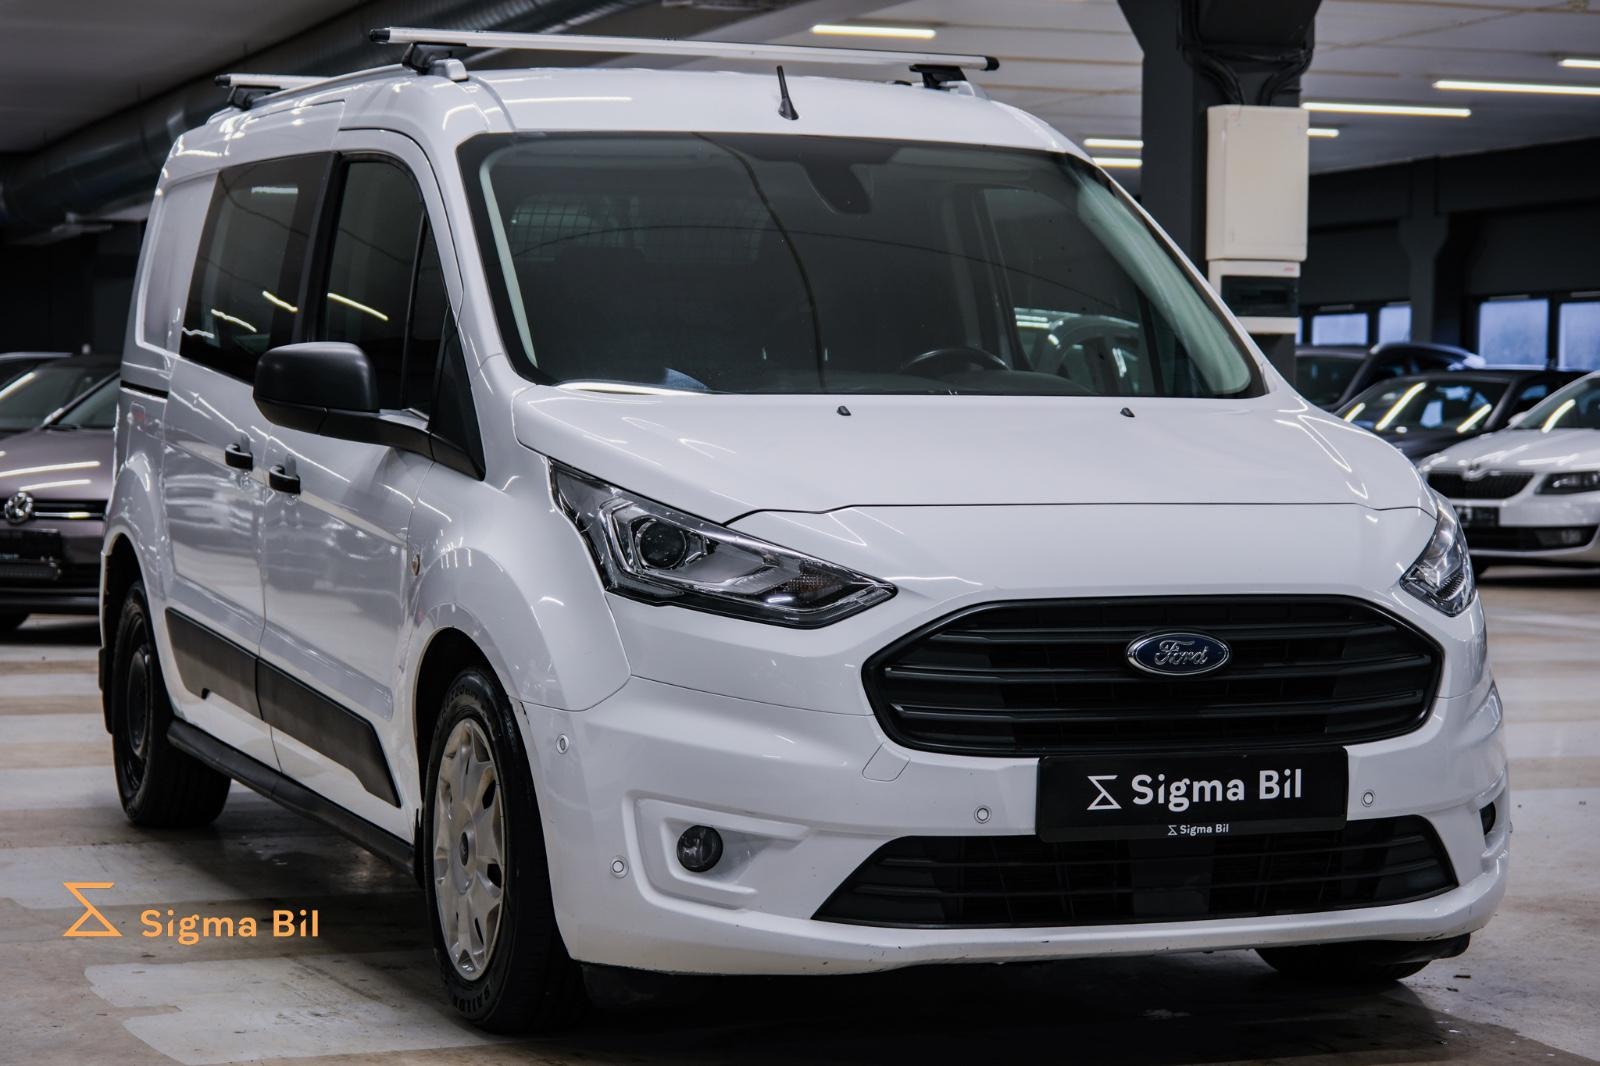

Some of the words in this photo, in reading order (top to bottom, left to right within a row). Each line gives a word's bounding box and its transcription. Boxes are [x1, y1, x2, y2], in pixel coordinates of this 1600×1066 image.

[1154, 640, 1209, 665] Ford
[1132, 774, 1244, 812] Sigma
[1260, 769, 1301, 799] Bil
[1180, 825, 1212, 836] Sigma
[1216, 824, 1229, 833] Bil
